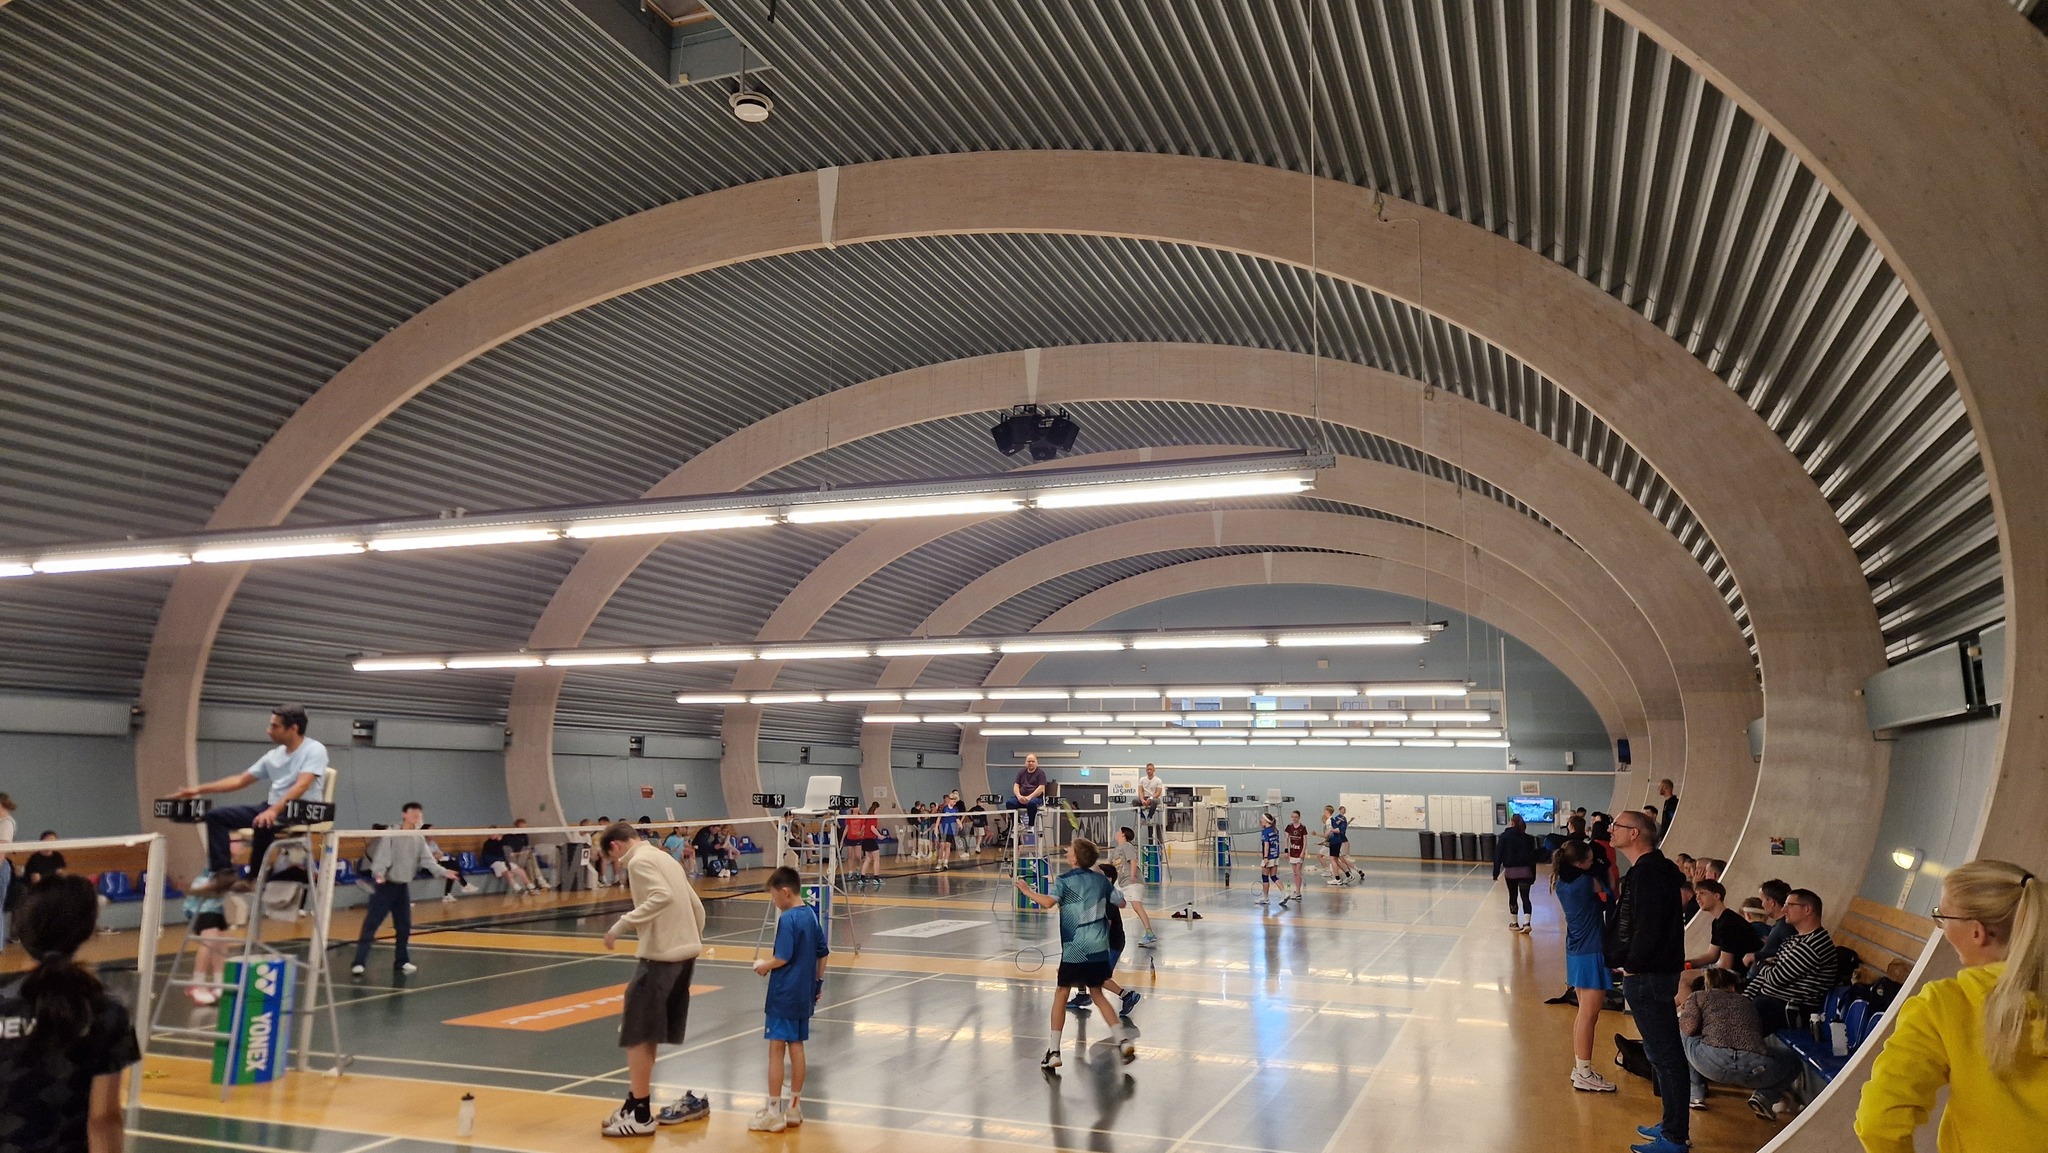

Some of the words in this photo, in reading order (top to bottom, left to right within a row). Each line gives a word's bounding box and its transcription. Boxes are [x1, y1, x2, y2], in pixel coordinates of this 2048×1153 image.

[753, 795, 763, 804] SET
[773, 794, 782, 806] 13
[830, 795, 840, 806] 20
[844, 797, 855, 806] SET
[155, 801, 172, 816] SET
[189, 800, 204, 817] 14
[305, 804, 326, 820] SET
[244, 1011, 273, 1072] YONEX
